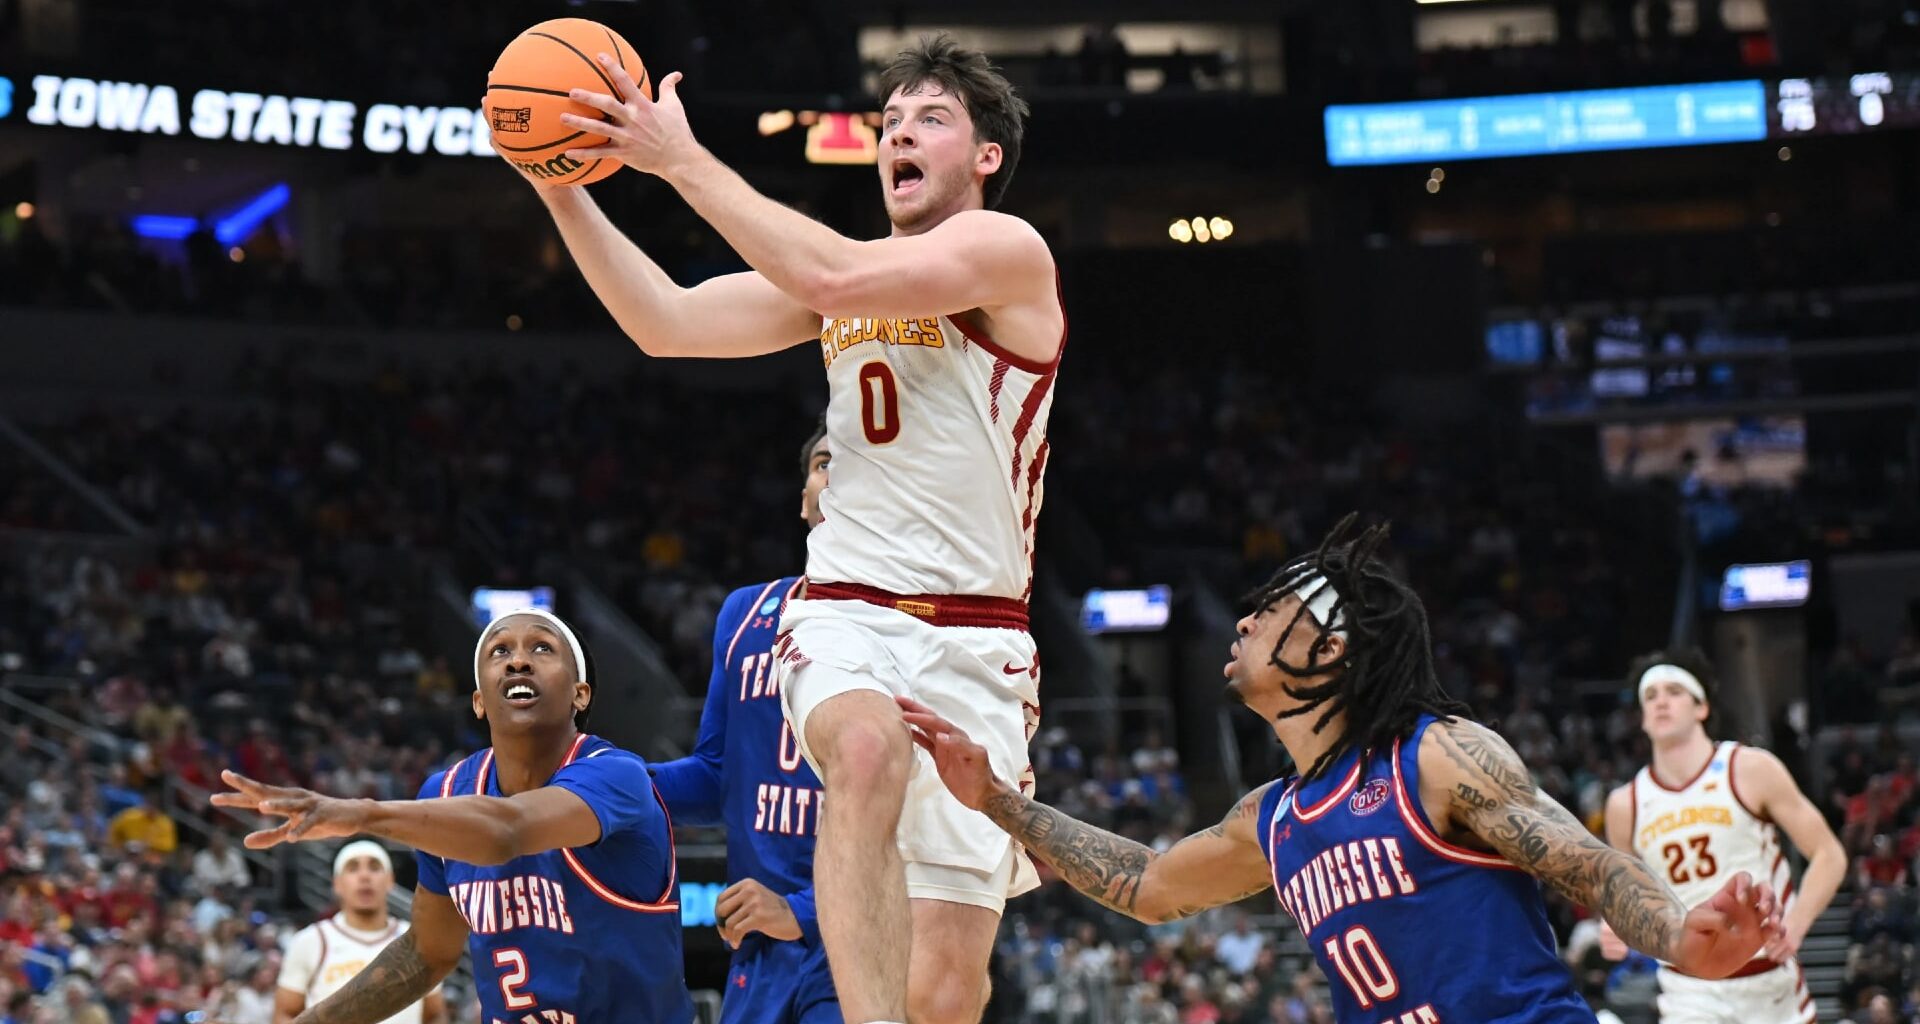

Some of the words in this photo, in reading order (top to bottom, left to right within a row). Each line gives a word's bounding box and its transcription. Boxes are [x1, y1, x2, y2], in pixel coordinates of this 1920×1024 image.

[27, 74, 181, 135] IOWA
[190, 88, 357, 150] STATE
[858, 359, 901, 446] 0
[1457, 783, 1497, 811] The
[1662, 834, 1717, 885] 23
[492, 946, 538, 1011] 2
[1323, 923, 1400, 1010] 10
